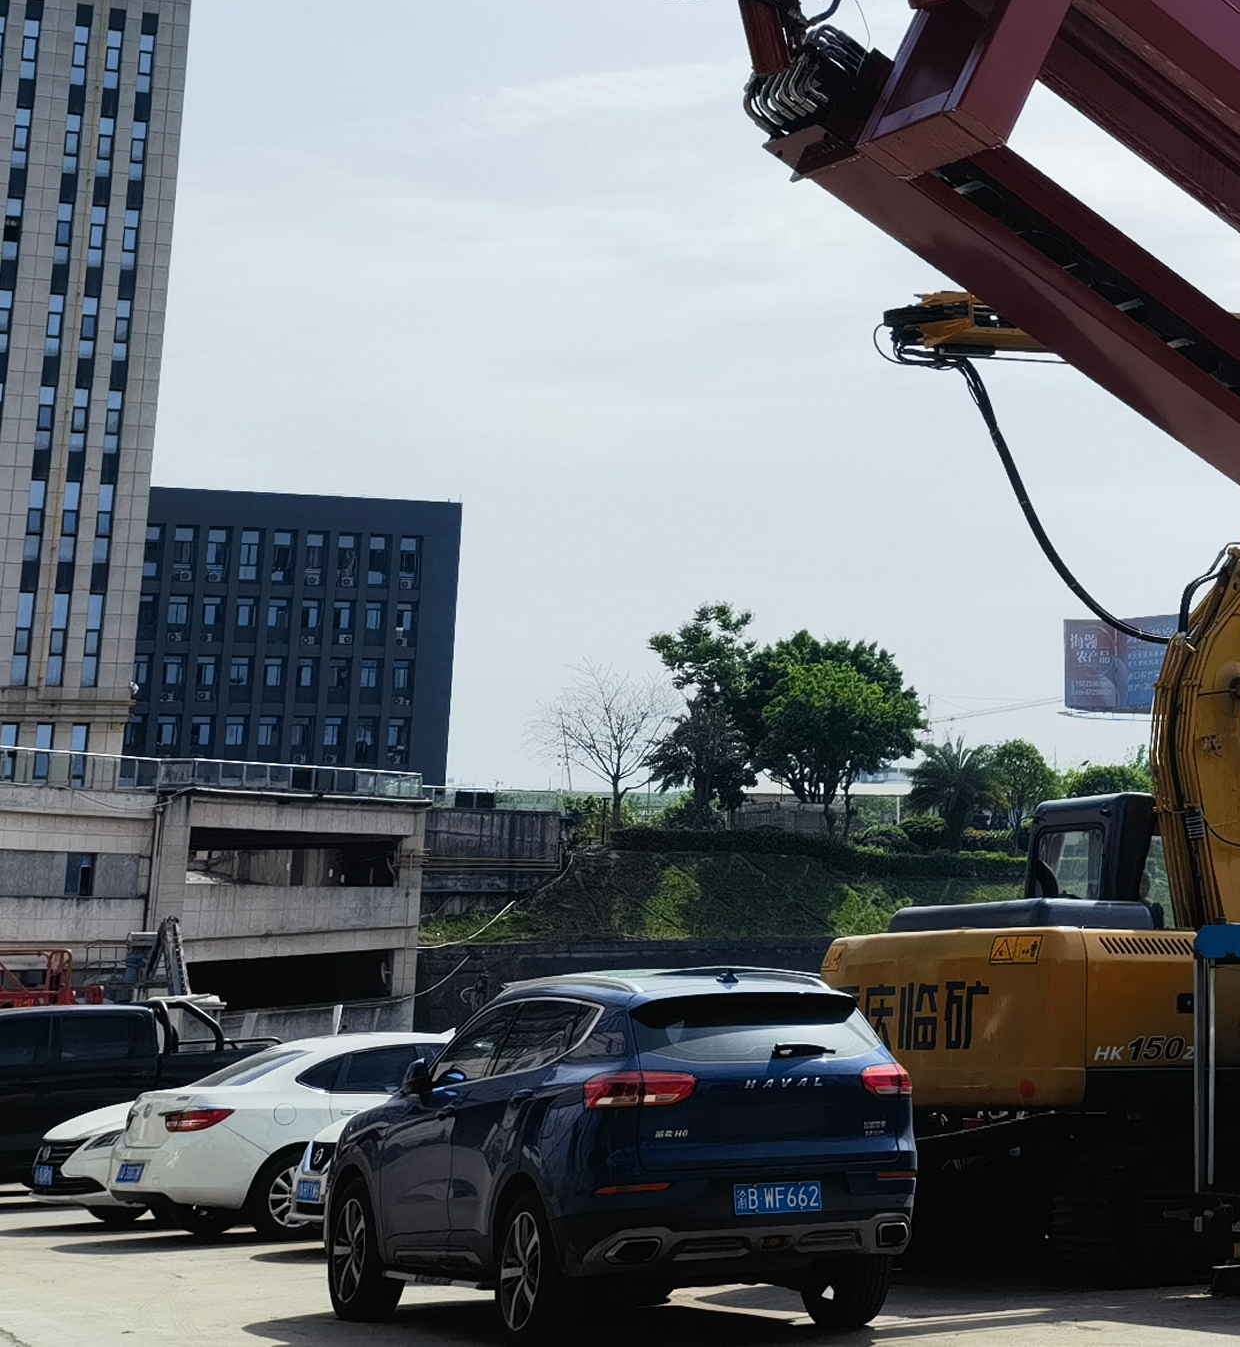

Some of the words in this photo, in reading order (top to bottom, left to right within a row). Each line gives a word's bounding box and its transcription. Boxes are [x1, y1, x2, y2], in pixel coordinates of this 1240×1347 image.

[838, 980, 990, 1051] 庆临矿
[744, 1077, 823, 1089] HAVAL
